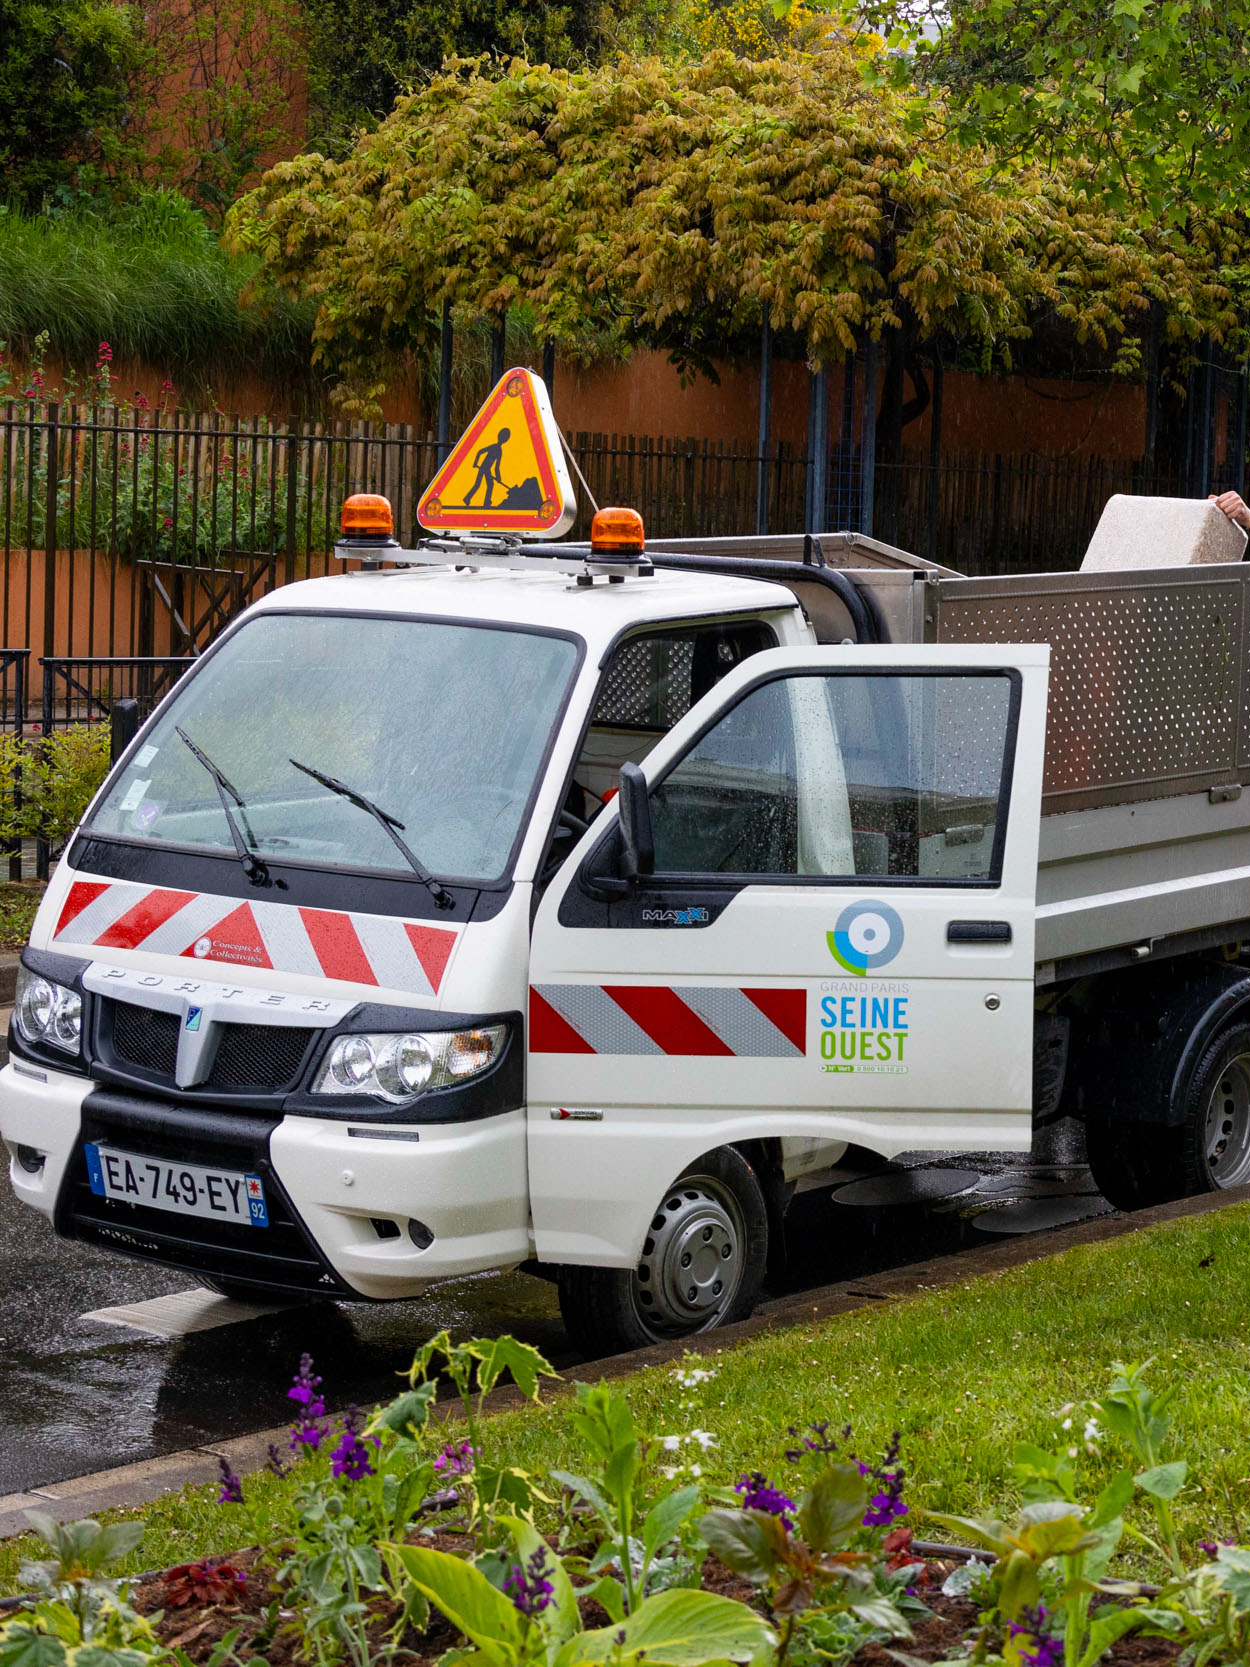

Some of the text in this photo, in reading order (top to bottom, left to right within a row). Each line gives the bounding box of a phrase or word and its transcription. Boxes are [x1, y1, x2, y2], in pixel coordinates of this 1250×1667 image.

[212, 940, 251, 952] Concepts
[103, 968, 331, 1011] PORTER
[820, 981, 910, 994] GRAND PARIS
[820, 996, 909, 1029] SEINE
[820, 1031, 909, 1061] OUEST
[93, 1155, 266, 1219] F EA-749-EY 92
